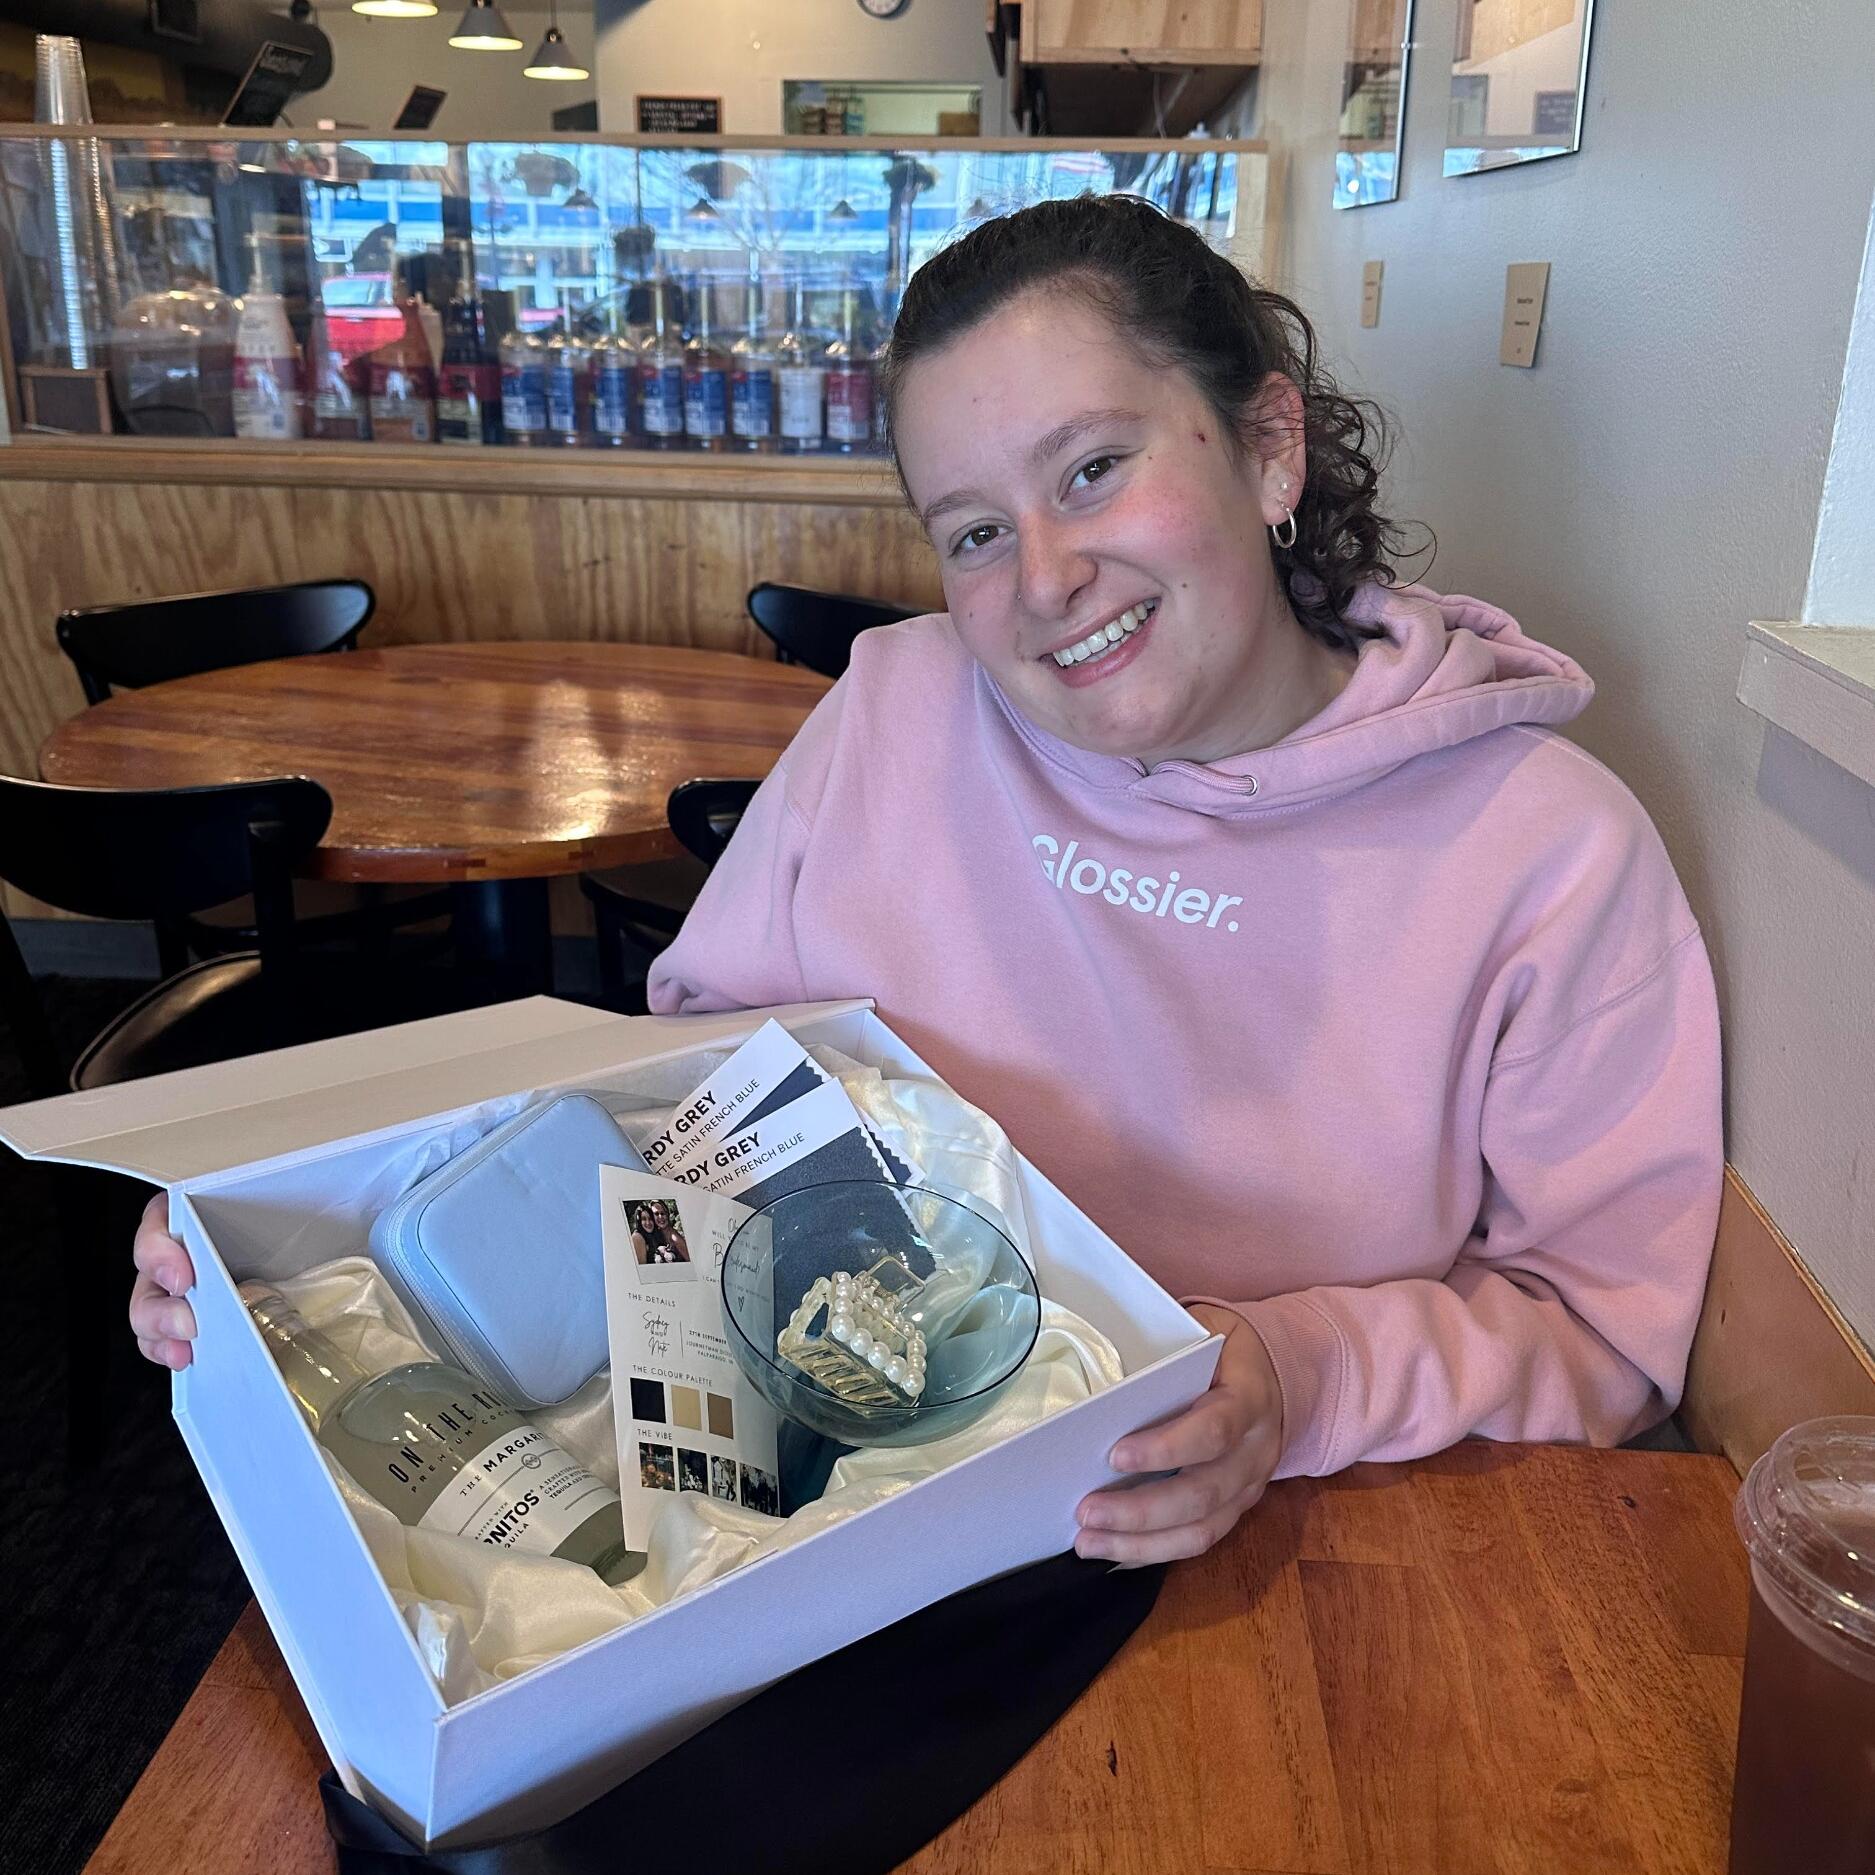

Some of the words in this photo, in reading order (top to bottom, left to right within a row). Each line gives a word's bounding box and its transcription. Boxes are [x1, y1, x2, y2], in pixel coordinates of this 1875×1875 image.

[673, 1135, 702, 1163] SATIN
[699, 1101, 737, 1138] FRENCH
[735, 1079, 760, 1103] BLUE
[675, 1090, 717, 1133] GREY
[714, 1131, 761, 1168] GREY
[735, 1149, 777, 1178] FRENCH
[777, 1132, 805, 1154] BLUE
[627, 1292, 642, 1301] THE
[645, 1295, 677, 1308] DETAILS
[632, 1364, 648, 1374] THE
[650, 1367, 683, 1380] COLOUR
[685, 1373, 713, 1387] PALETTE
[388, 1446, 425, 1483] ON
[426, 1402, 474, 1441] THE
[637, 1428, 653, 1438] THE
[410, 1429, 474, 1493] PREMIUM
[459, 1474, 483, 1497] THE
[549, 1482, 573, 1499] TEQUILA
